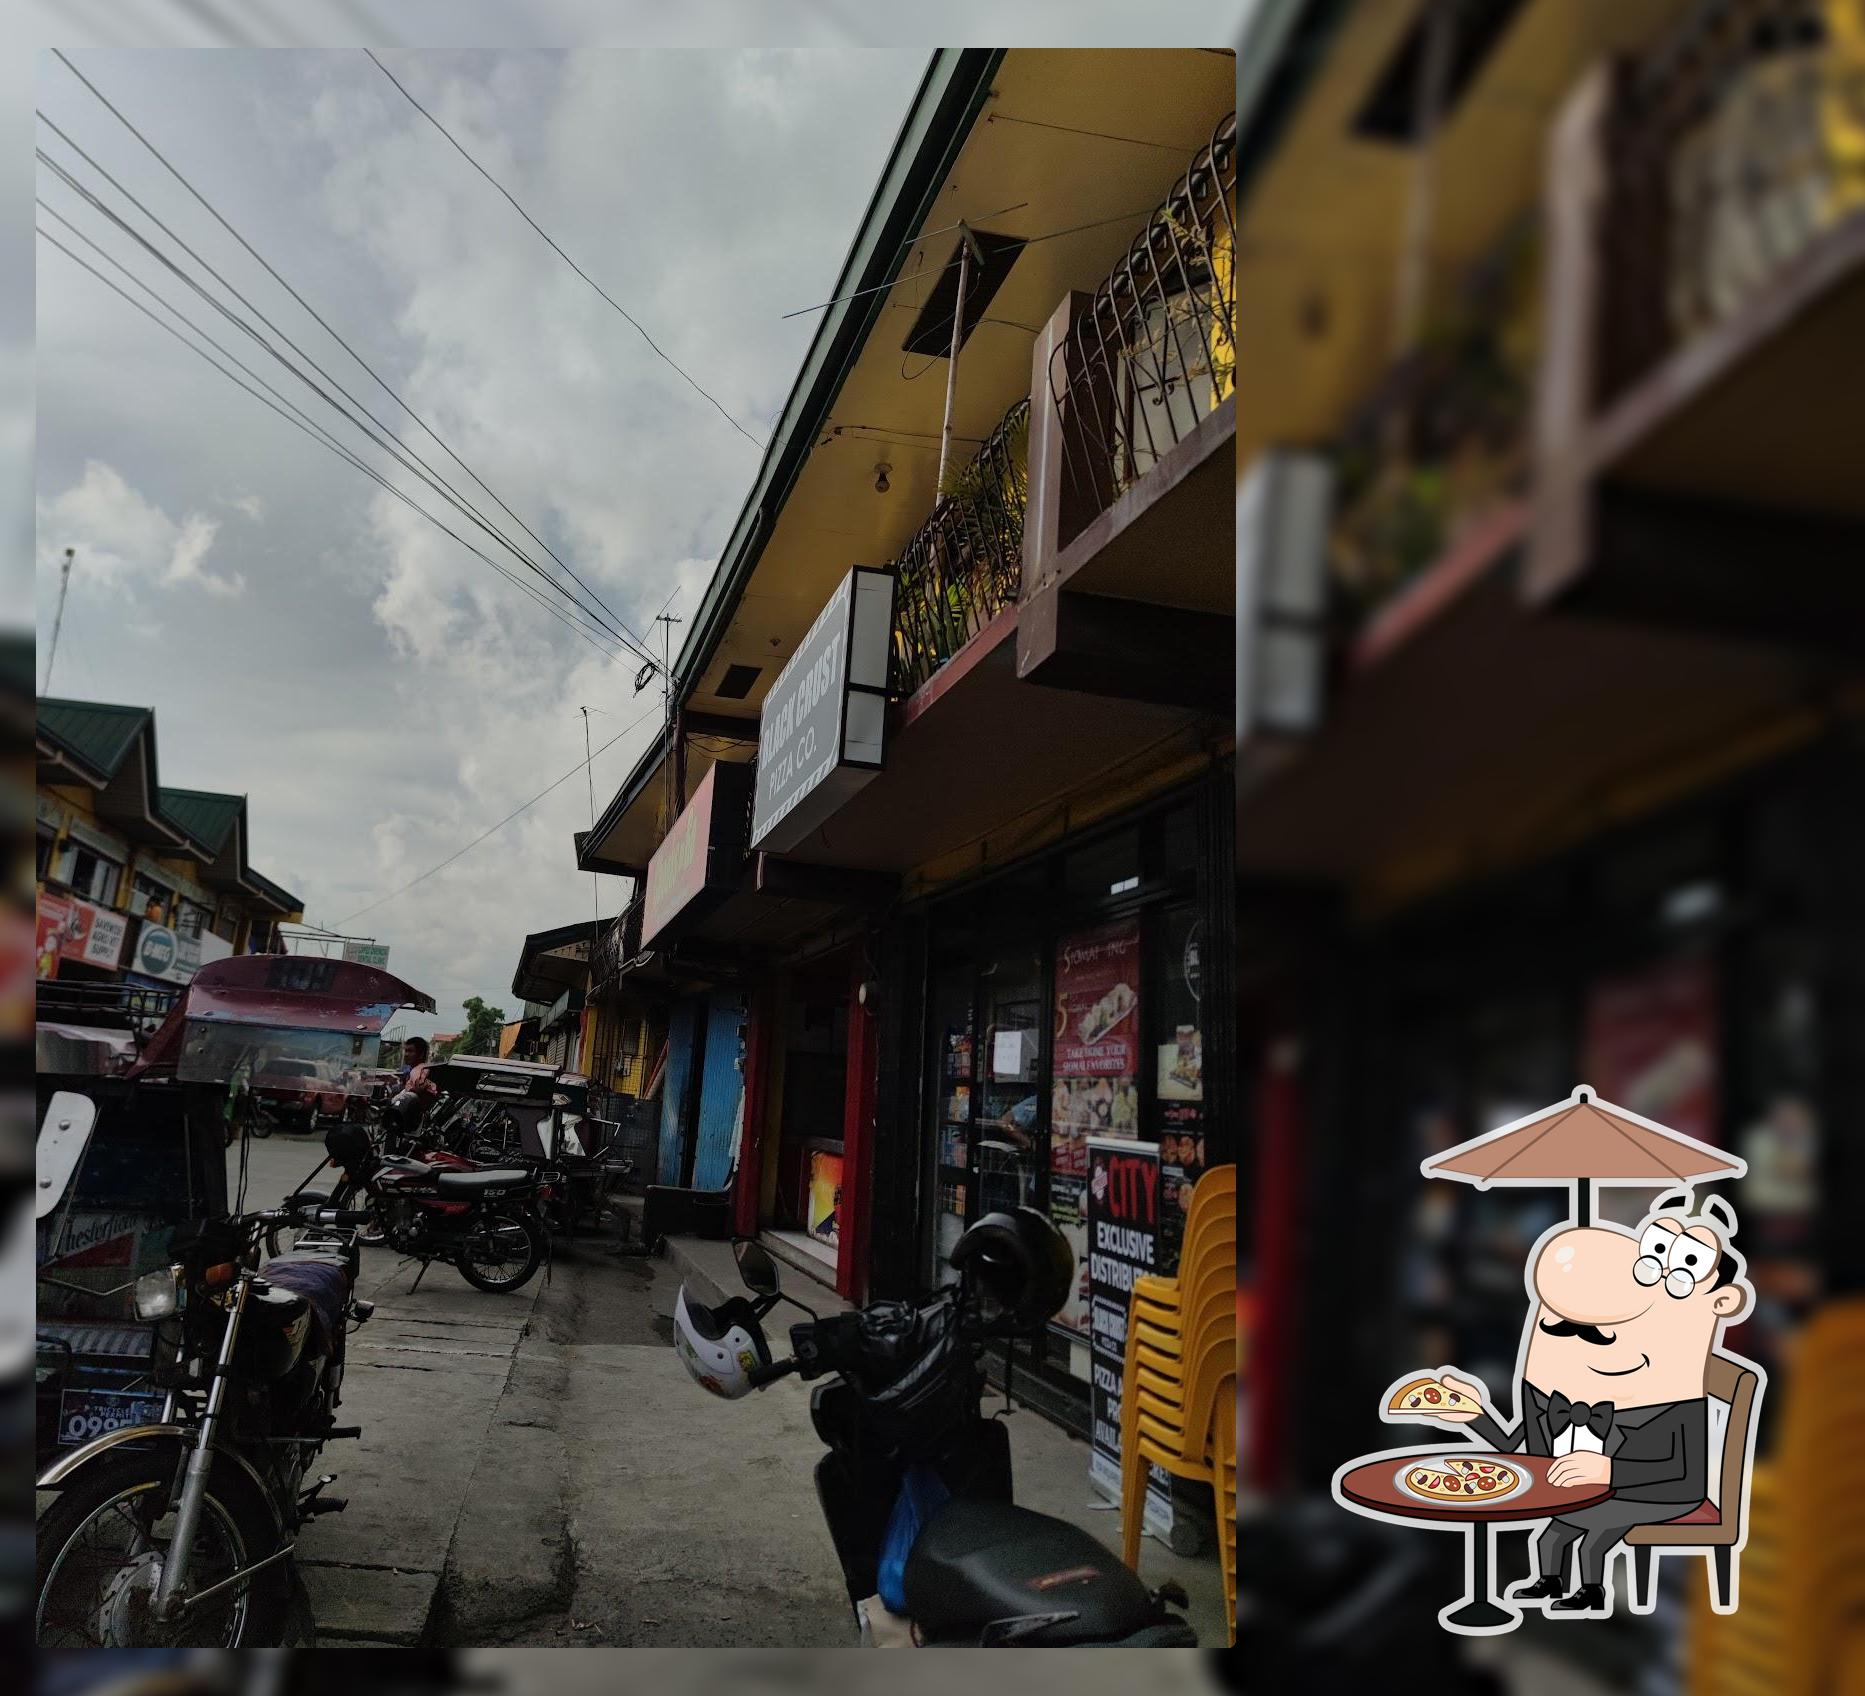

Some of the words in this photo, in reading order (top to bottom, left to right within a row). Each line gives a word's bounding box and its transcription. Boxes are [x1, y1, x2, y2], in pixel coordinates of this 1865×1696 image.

[761, 690, 796, 771] BLACK
[796, 631, 841, 728] CRUST
[769, 751, 793, 801] PIZZA
[797, 726, 817, 769] CO.
[1107, 1152, 1159, 1226] CITY
[1097, 1220, 1155, 1265] EXCLUSIVE
[1094, 1363, 1117, 1397] PIZZA
